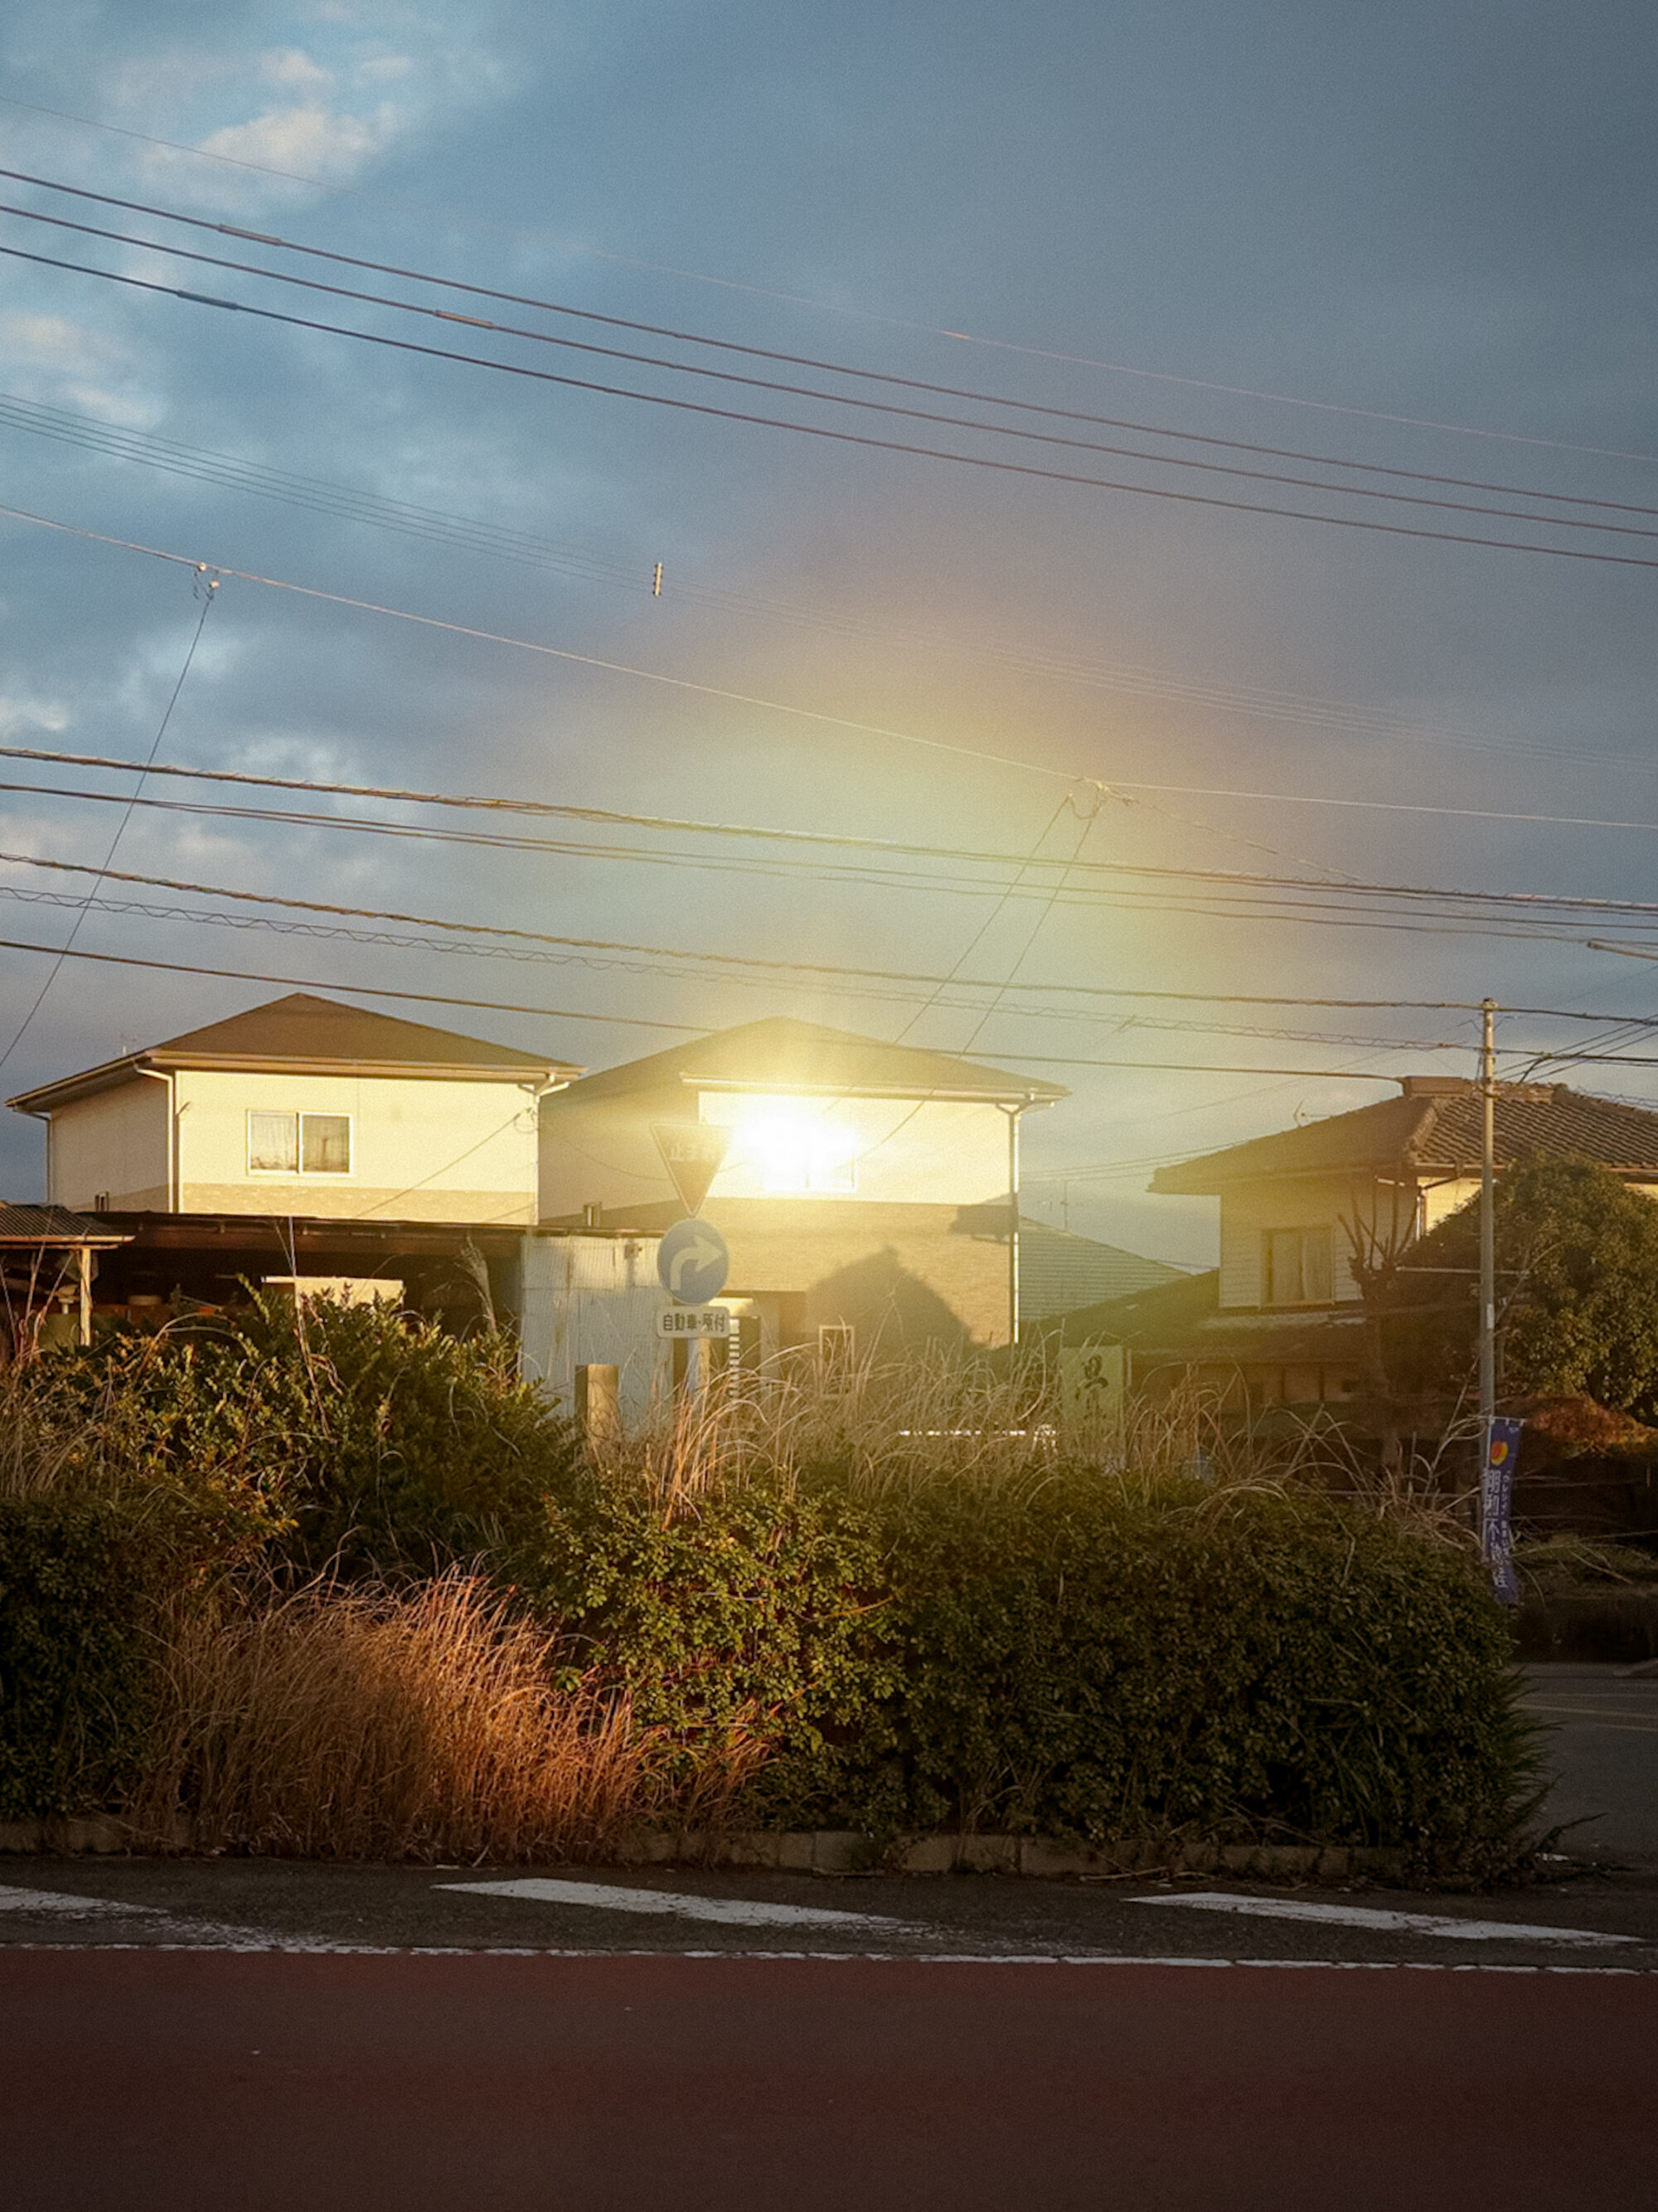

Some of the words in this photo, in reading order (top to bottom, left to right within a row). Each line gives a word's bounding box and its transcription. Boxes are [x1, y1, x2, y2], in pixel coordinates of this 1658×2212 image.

[663, 1313, 725, 1332] 自動車・原付
